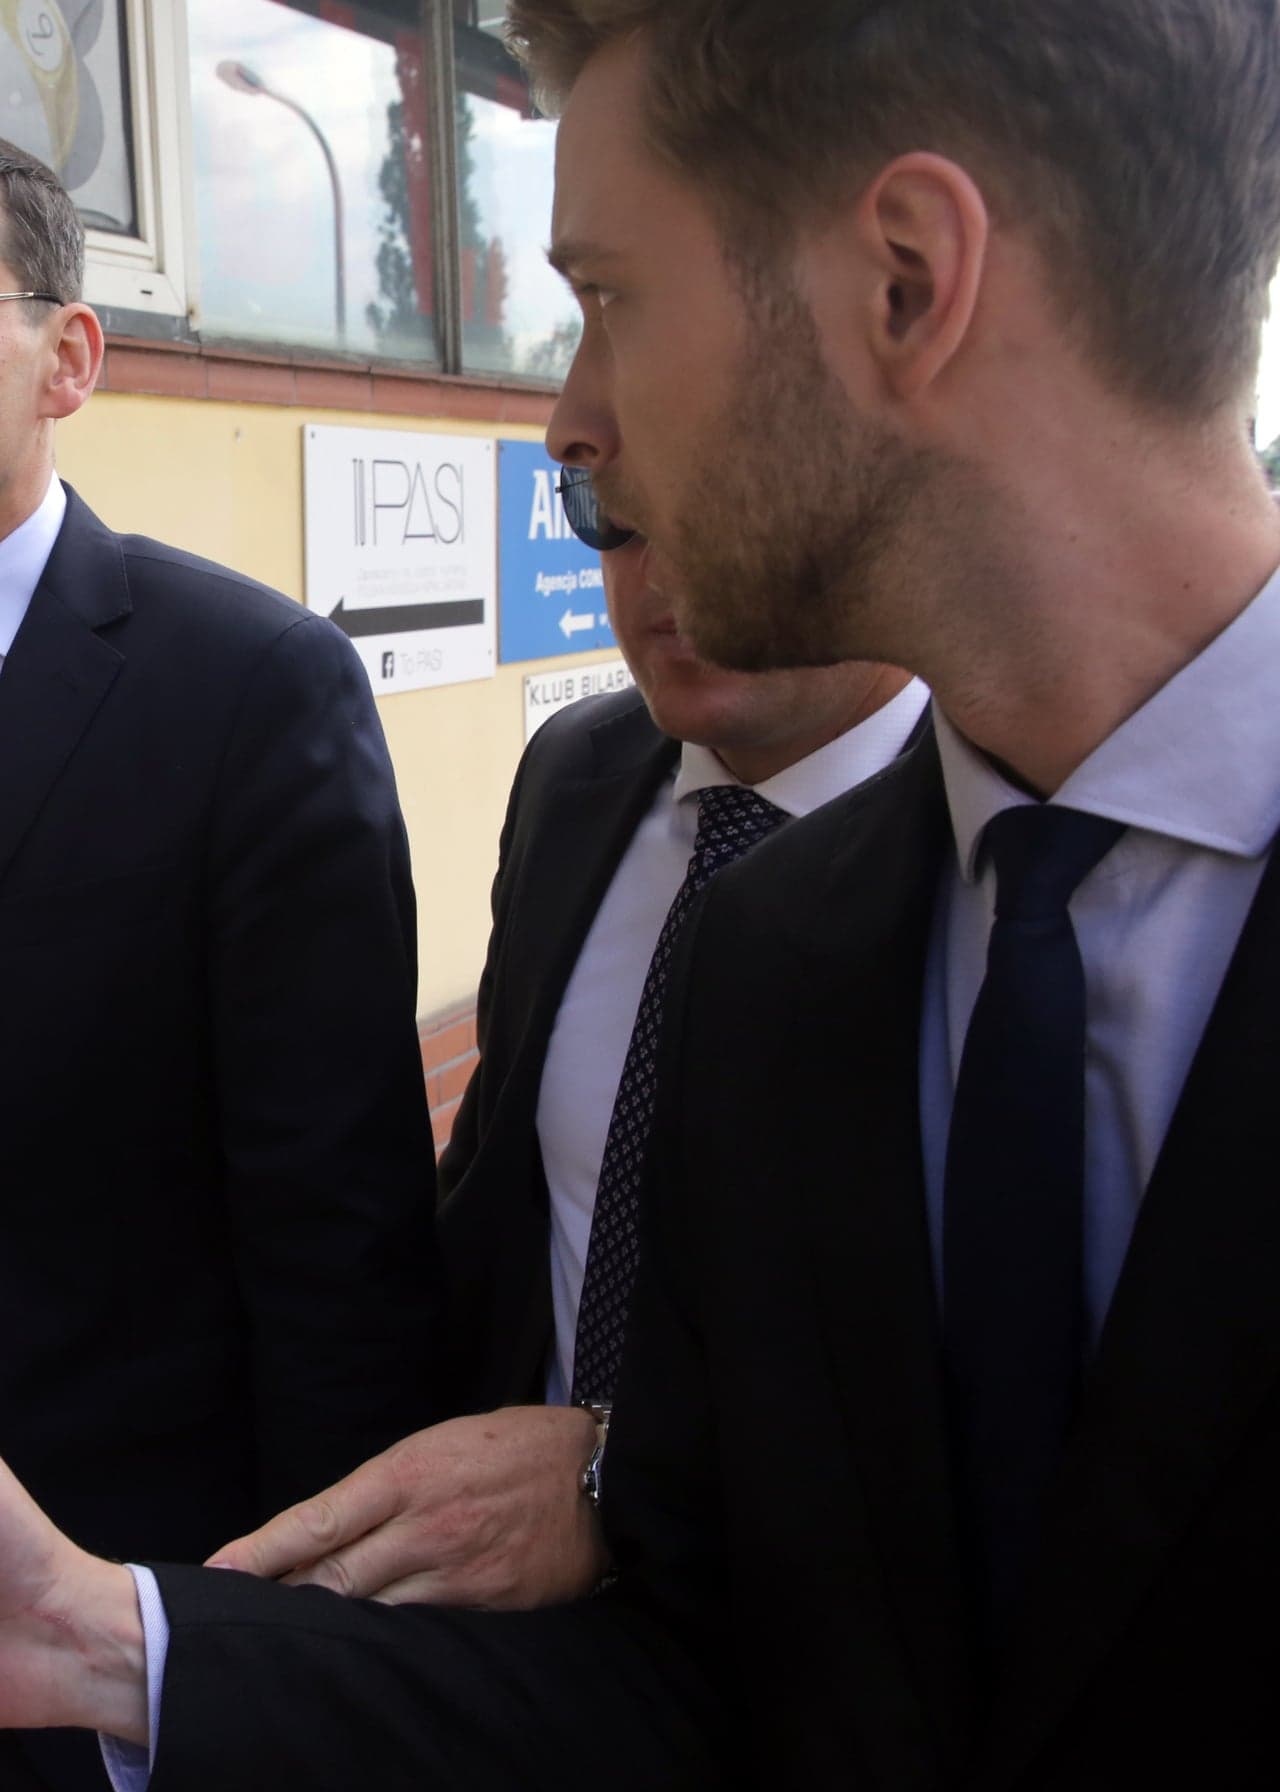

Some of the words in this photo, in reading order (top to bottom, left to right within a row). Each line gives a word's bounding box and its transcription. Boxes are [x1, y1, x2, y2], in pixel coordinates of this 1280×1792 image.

[535, 570, 577, 596] Agencja
[530, 678, 574, 706] KLUB
[581, 669, 631, 697] BILAR
